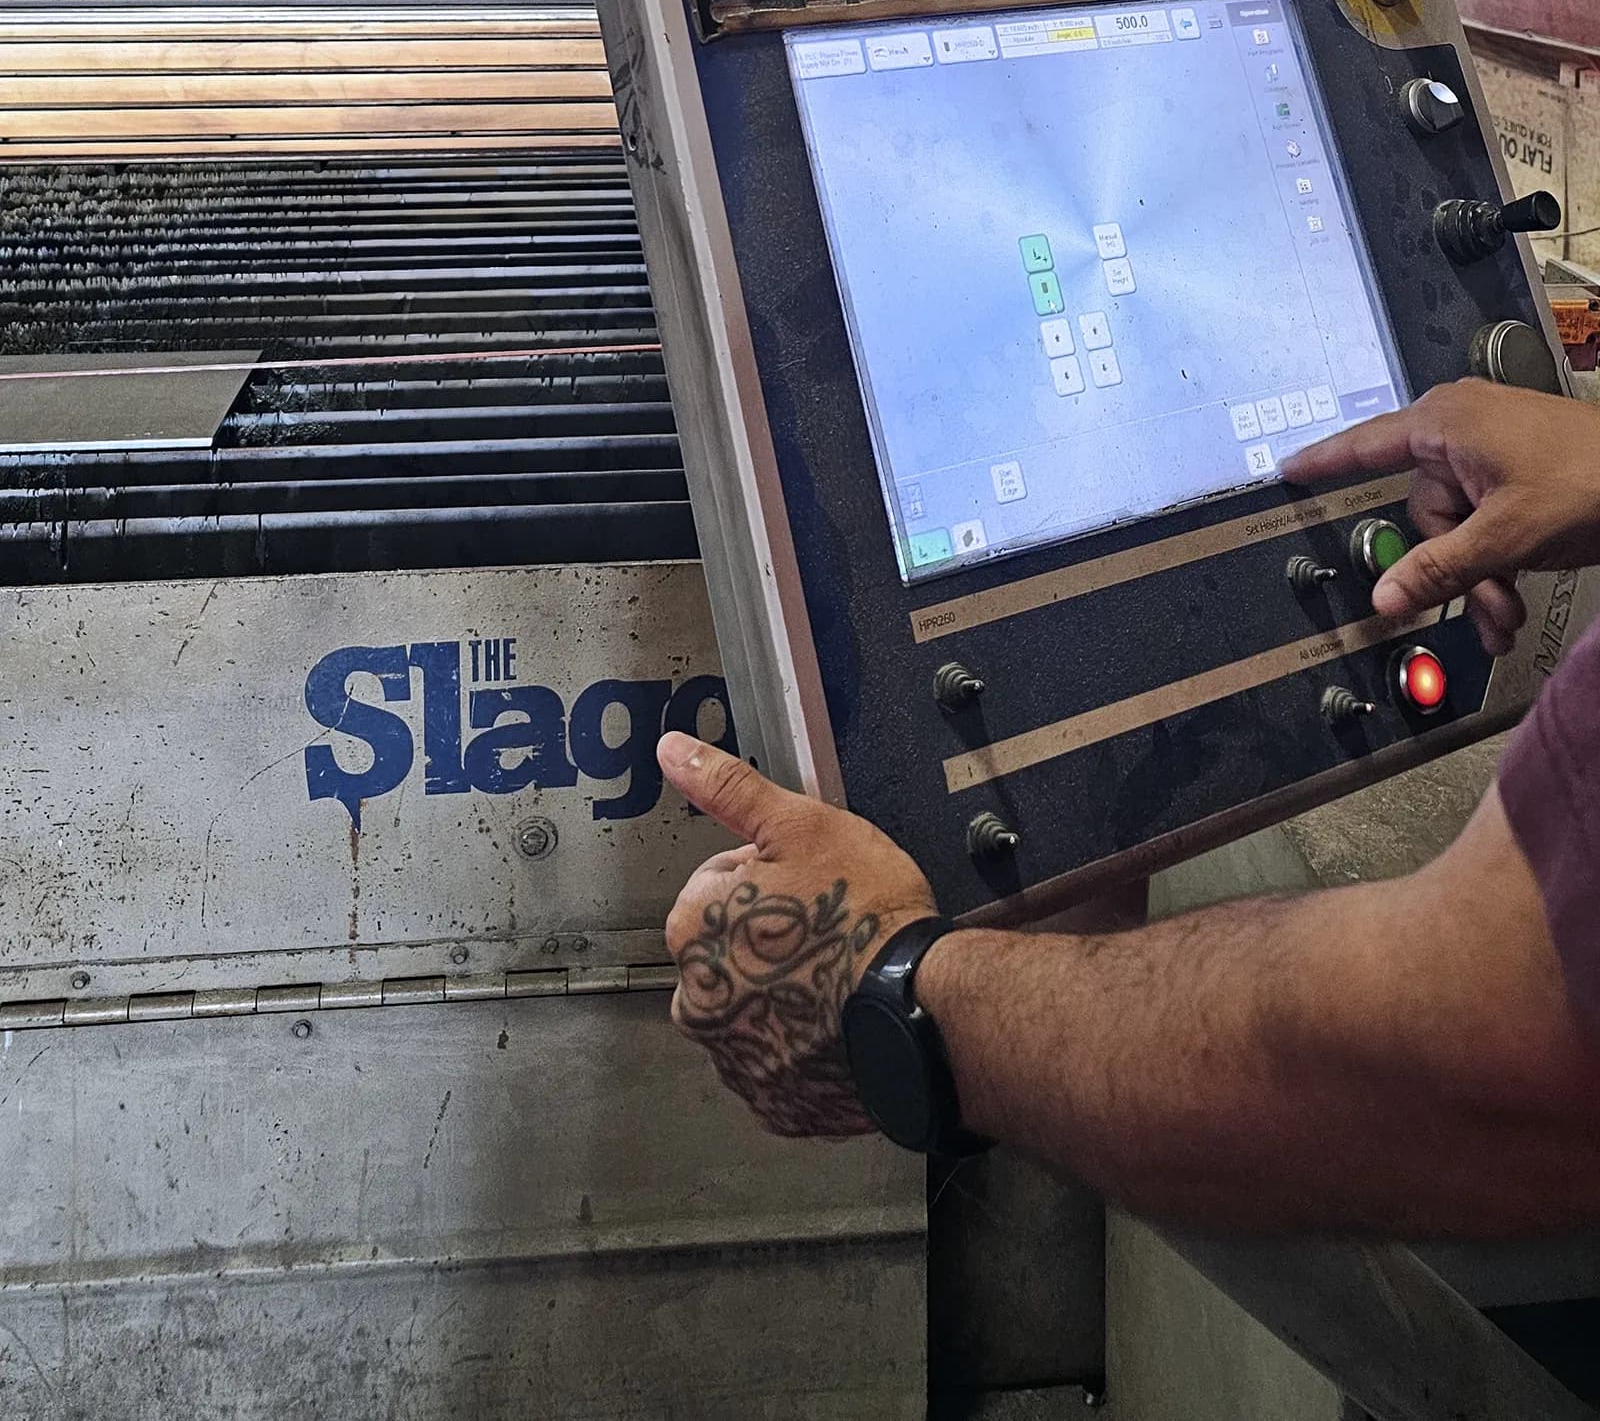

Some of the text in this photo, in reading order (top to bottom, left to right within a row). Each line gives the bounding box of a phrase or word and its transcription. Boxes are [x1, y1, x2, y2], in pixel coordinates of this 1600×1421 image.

[1116, 15, 1149, 30] 500.0
[1537, 133, 1552, 149] FOR
[1519, 143, 1552, 175] FLAT
[1364, 489, 1383, 503] Start
[1245, 524, 1259, 536] Set
[918, 611, 957, 632] HPR260
[468, 638, 517, 681] THE
